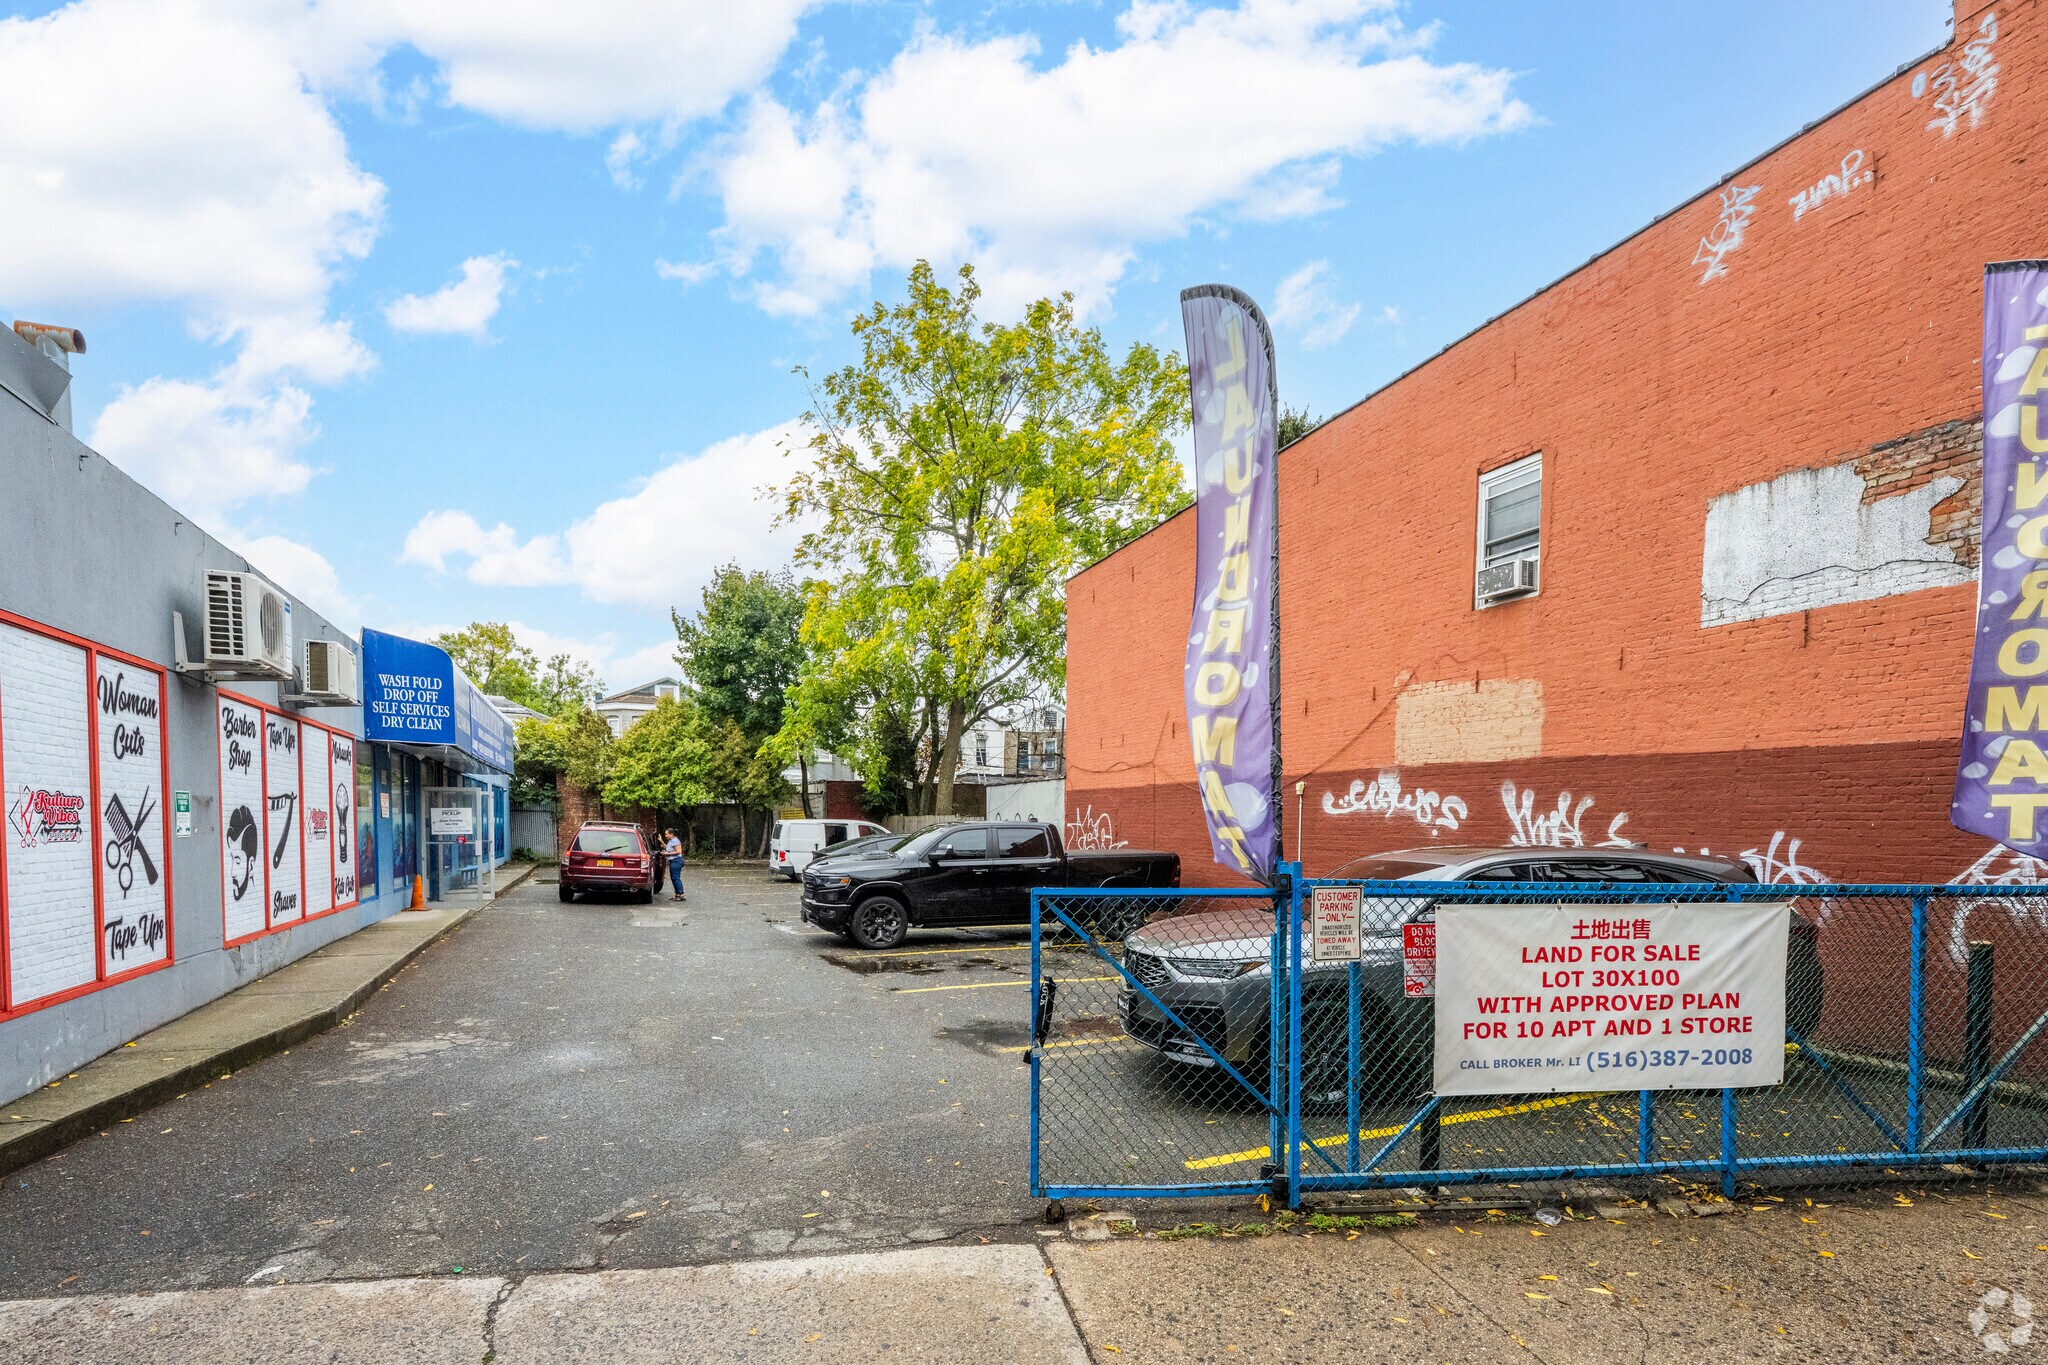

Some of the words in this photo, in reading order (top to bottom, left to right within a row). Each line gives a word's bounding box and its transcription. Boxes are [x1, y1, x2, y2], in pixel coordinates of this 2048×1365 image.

[378, 673, 410, 688] WASH
[412, 676, 442, 690] FOLD
[97, 672, 158, 719] Woman
[383, 688, 415, 701] DROP
[417, 690, 438, 703] OFF
[372, 701, 398, 714] SELF
[400, 703, 450, 718] SERVICES
[222, 707, 257, 739] Barber
[382, 715, 404, 728] DRY
[406, 717, 442, 730] CLEAN
[113, 723, 145, 760] Cuts
[266, 722, 282, 752] Tape
[283, 727, 296, 755] Ups
[229, 740, 252, 775] Shop
[34, 790, 84, 814] Kulture
[43, 809, 79, 828] Vibes
[273, 890, 297, 919] Shaves
[1317, 892, 1358, 901] CUSTOMER
[1320, 903, 1353, 911] PARKING
[1325, 913, 1347, 922] ONLY
[105, 916, 137, 960] Tape
[139, 913, 164, 951] Ups
[1411, 927, 1423, 936] DO
[1571, 919, 1651, 940] 土地出售
[1414, 938, 1436, 946] BLOC
[1521, 947, 1583, 964] LAND
[1591, 945, 1636, 962] FOR
[1643, 944, 1701, 962] SALE
[1542, 971, 1585, 988] LOT
[1592, 969, 1680, 987] 30X100
[1477, 997, 1542, 1014] WITH
[1550, 994, 1674, 1012] APPROVED
[1682, 992, 1740, 1010] PLAN
[1463, 1022, 1508, 1040] FOR
[1516, 1021, 1544, 1038] 10
[1551, 1020, 1596, 1037] APT
[1603, 1019, 1652, 1036] AND
[1662, 1018, 1672, 1035] 1
[1680, 1016, 1753, 1034] STORE
[1460, 1060, 1490, 1070] CALL
[1493, 1058, 1542, 1069] BROKER
[1546, 1057, 1565, 1067] Mr.
[1569, 1057, 1581, 1066] LI
[1586, 1048, 1753, 1072] (516)387-2008
